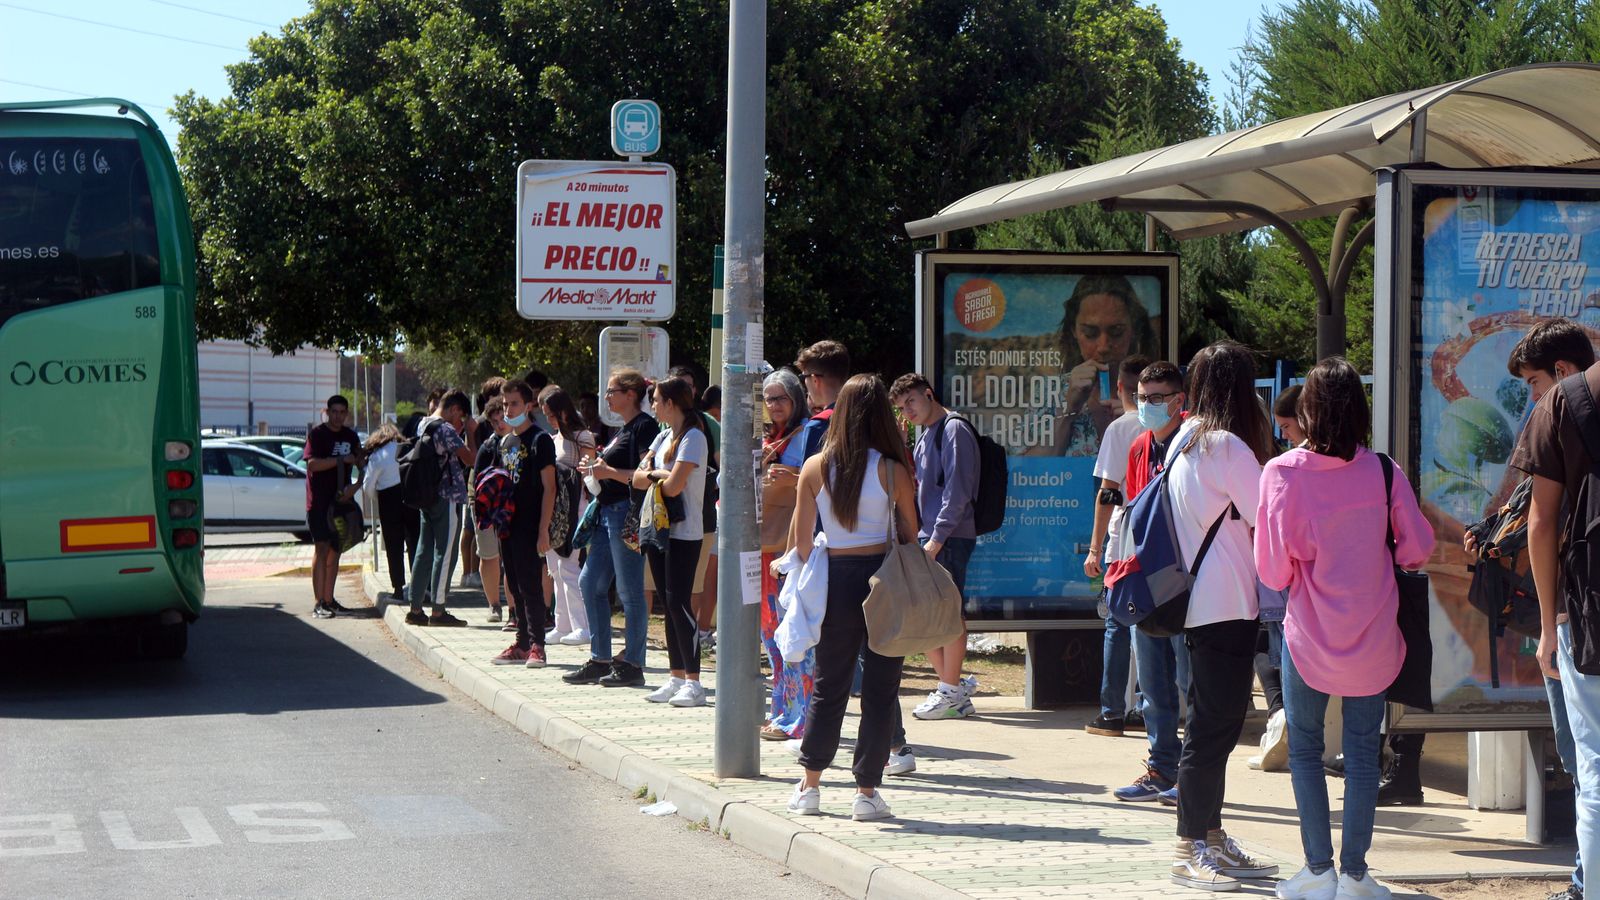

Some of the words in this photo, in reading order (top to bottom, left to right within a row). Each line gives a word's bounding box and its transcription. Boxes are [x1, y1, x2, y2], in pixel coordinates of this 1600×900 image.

[624, 143, 647, 153] BUS
[566, 182, 575, 192] A
[575, 182, 587, 192] 20
[588, 182, 629, 193] minutos
[576, 203, 664, 232] MEJOR
[1475, 232, 1582, 262] REFRESCA
[1477, 260, 1505, 288] TU
[1505, 262, 1587, 290] CUERPO
[539, 287, 594, 305] Media
[606, 287, 656, 305] Markt
[965, 295, 992, 313] SABOR
[1529, 289, 1583, 317] PERO
[135, 307, 156, 319] 588
[965, 313, 970, 325] A
[971, 306, 996, 323] FRESA
[955, 346, 986, 367] ESTÉS
[990, 351, 1026, 367] DONDE
[1029, 347, 1064, 368] ESTÉS,
[951, 375, 978, 408] AL
[985, 375, 1068, 413] DOLOR,
[993, 414, 1055, 447] AGUA
[1005, 496, 1079, 511] ibuprofeno
[1003, 514, 1016, 526] en
[1020, 509, 1068, 526] formato
[0, 801, 358, 857] BUS
